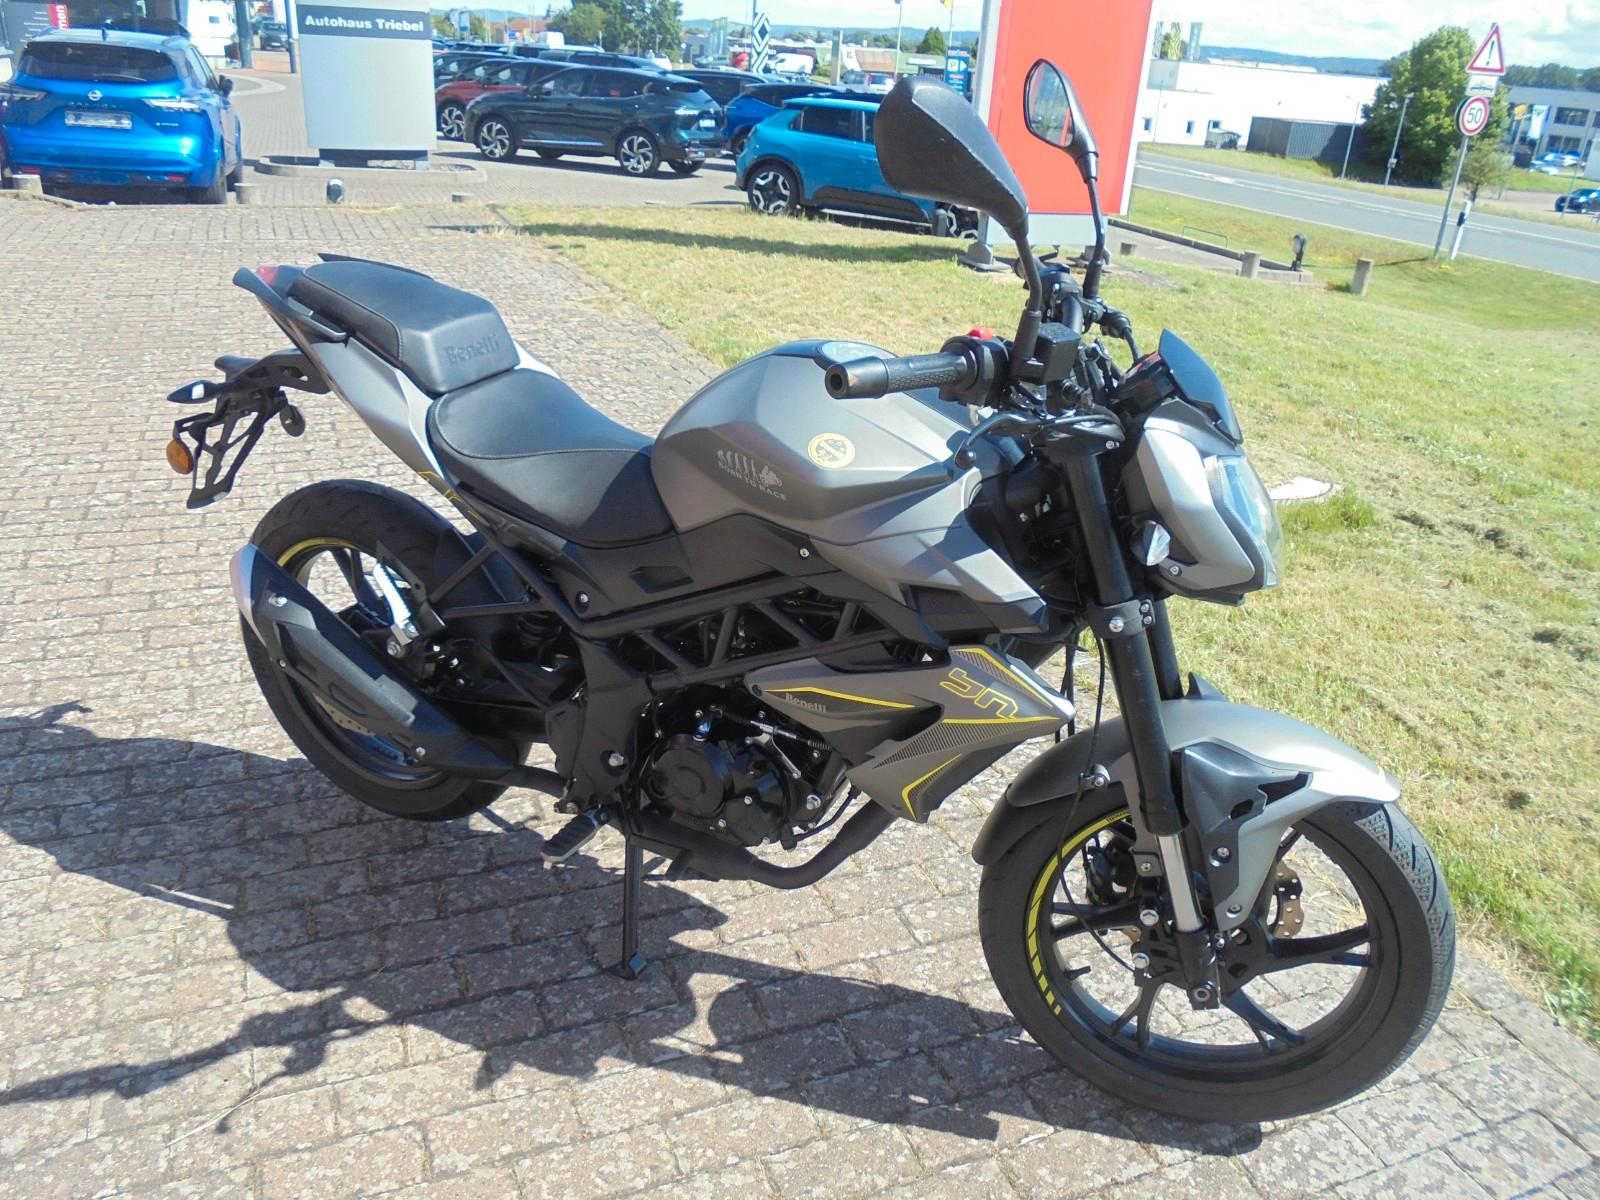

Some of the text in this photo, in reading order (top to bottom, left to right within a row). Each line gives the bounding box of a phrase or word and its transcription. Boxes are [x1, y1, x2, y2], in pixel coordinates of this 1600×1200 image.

[305, 15, 424, 32] Autohaus Triebel
[1466, 107, 1483, 124] 50
[444, 332, 499, 363] Benelli
[785, 692, 827, 713] Benelli
